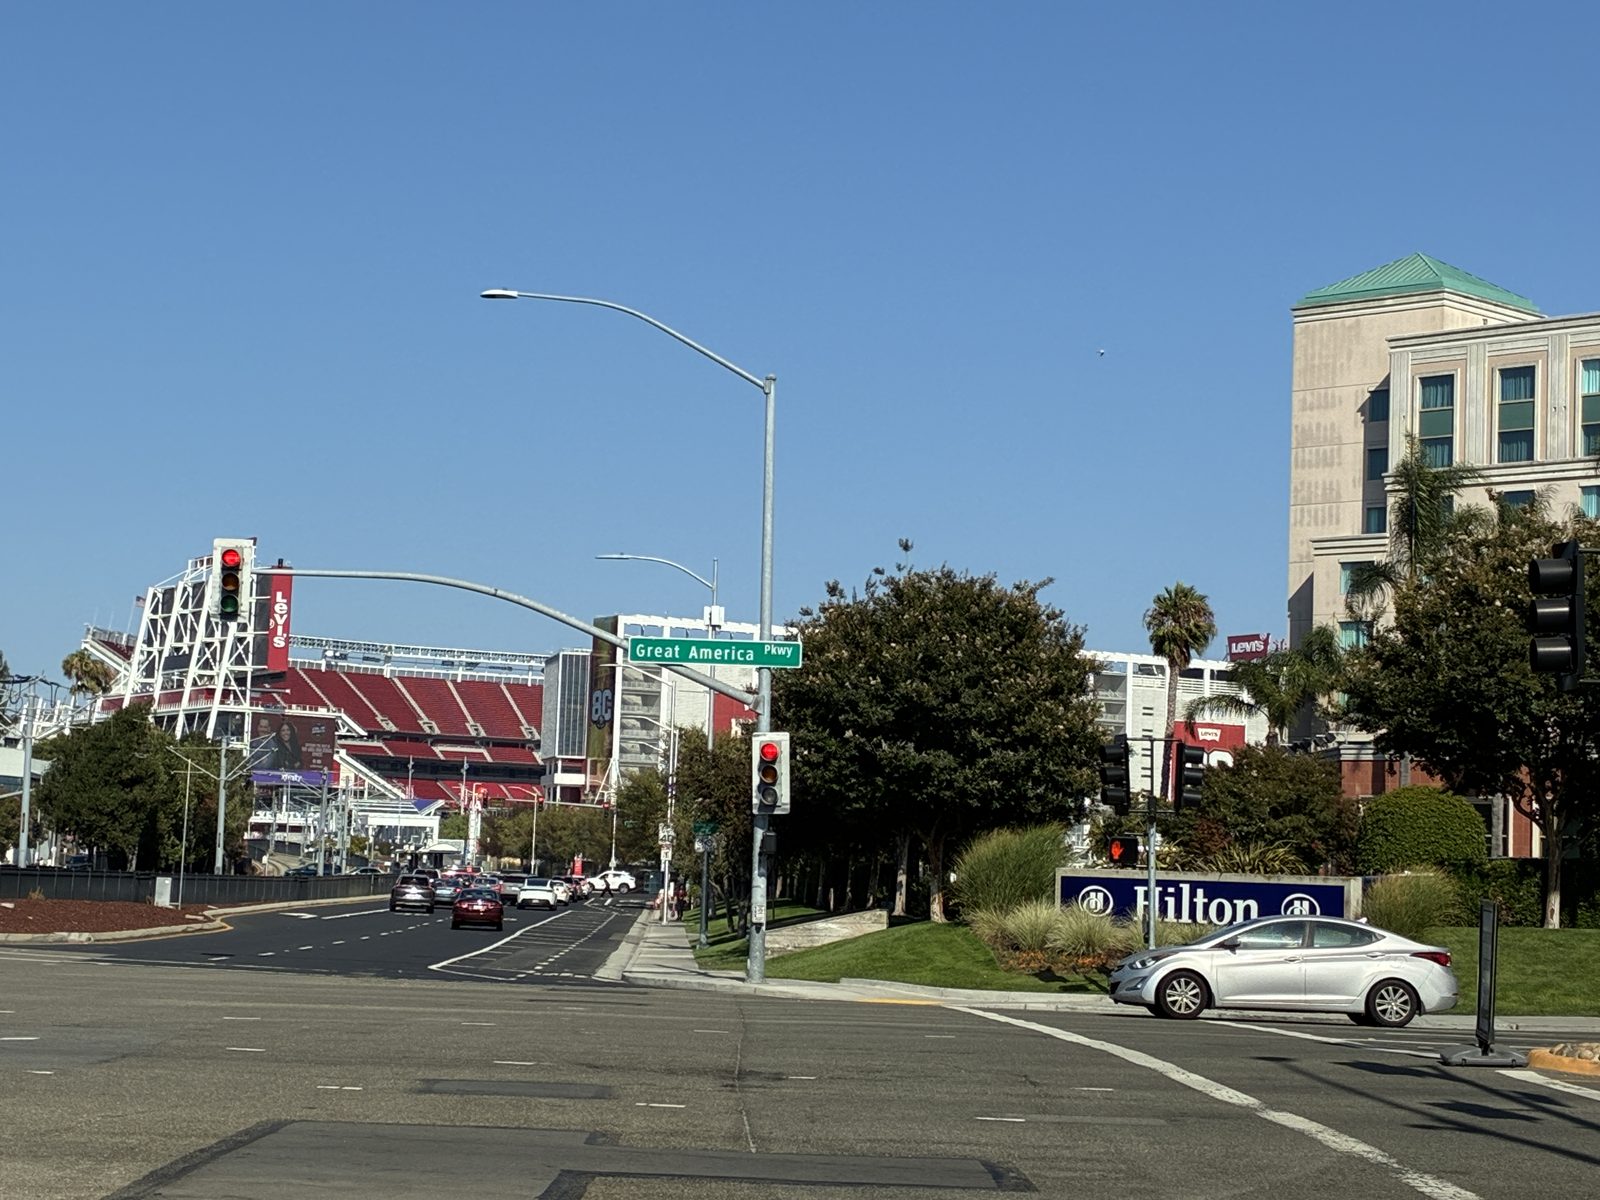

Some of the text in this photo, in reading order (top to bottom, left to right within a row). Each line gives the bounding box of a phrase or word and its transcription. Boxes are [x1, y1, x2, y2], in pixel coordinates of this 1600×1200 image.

[636, 644, 793, 661] Great America Pkwy
[1133, 883, 1260, 926] Hilton
